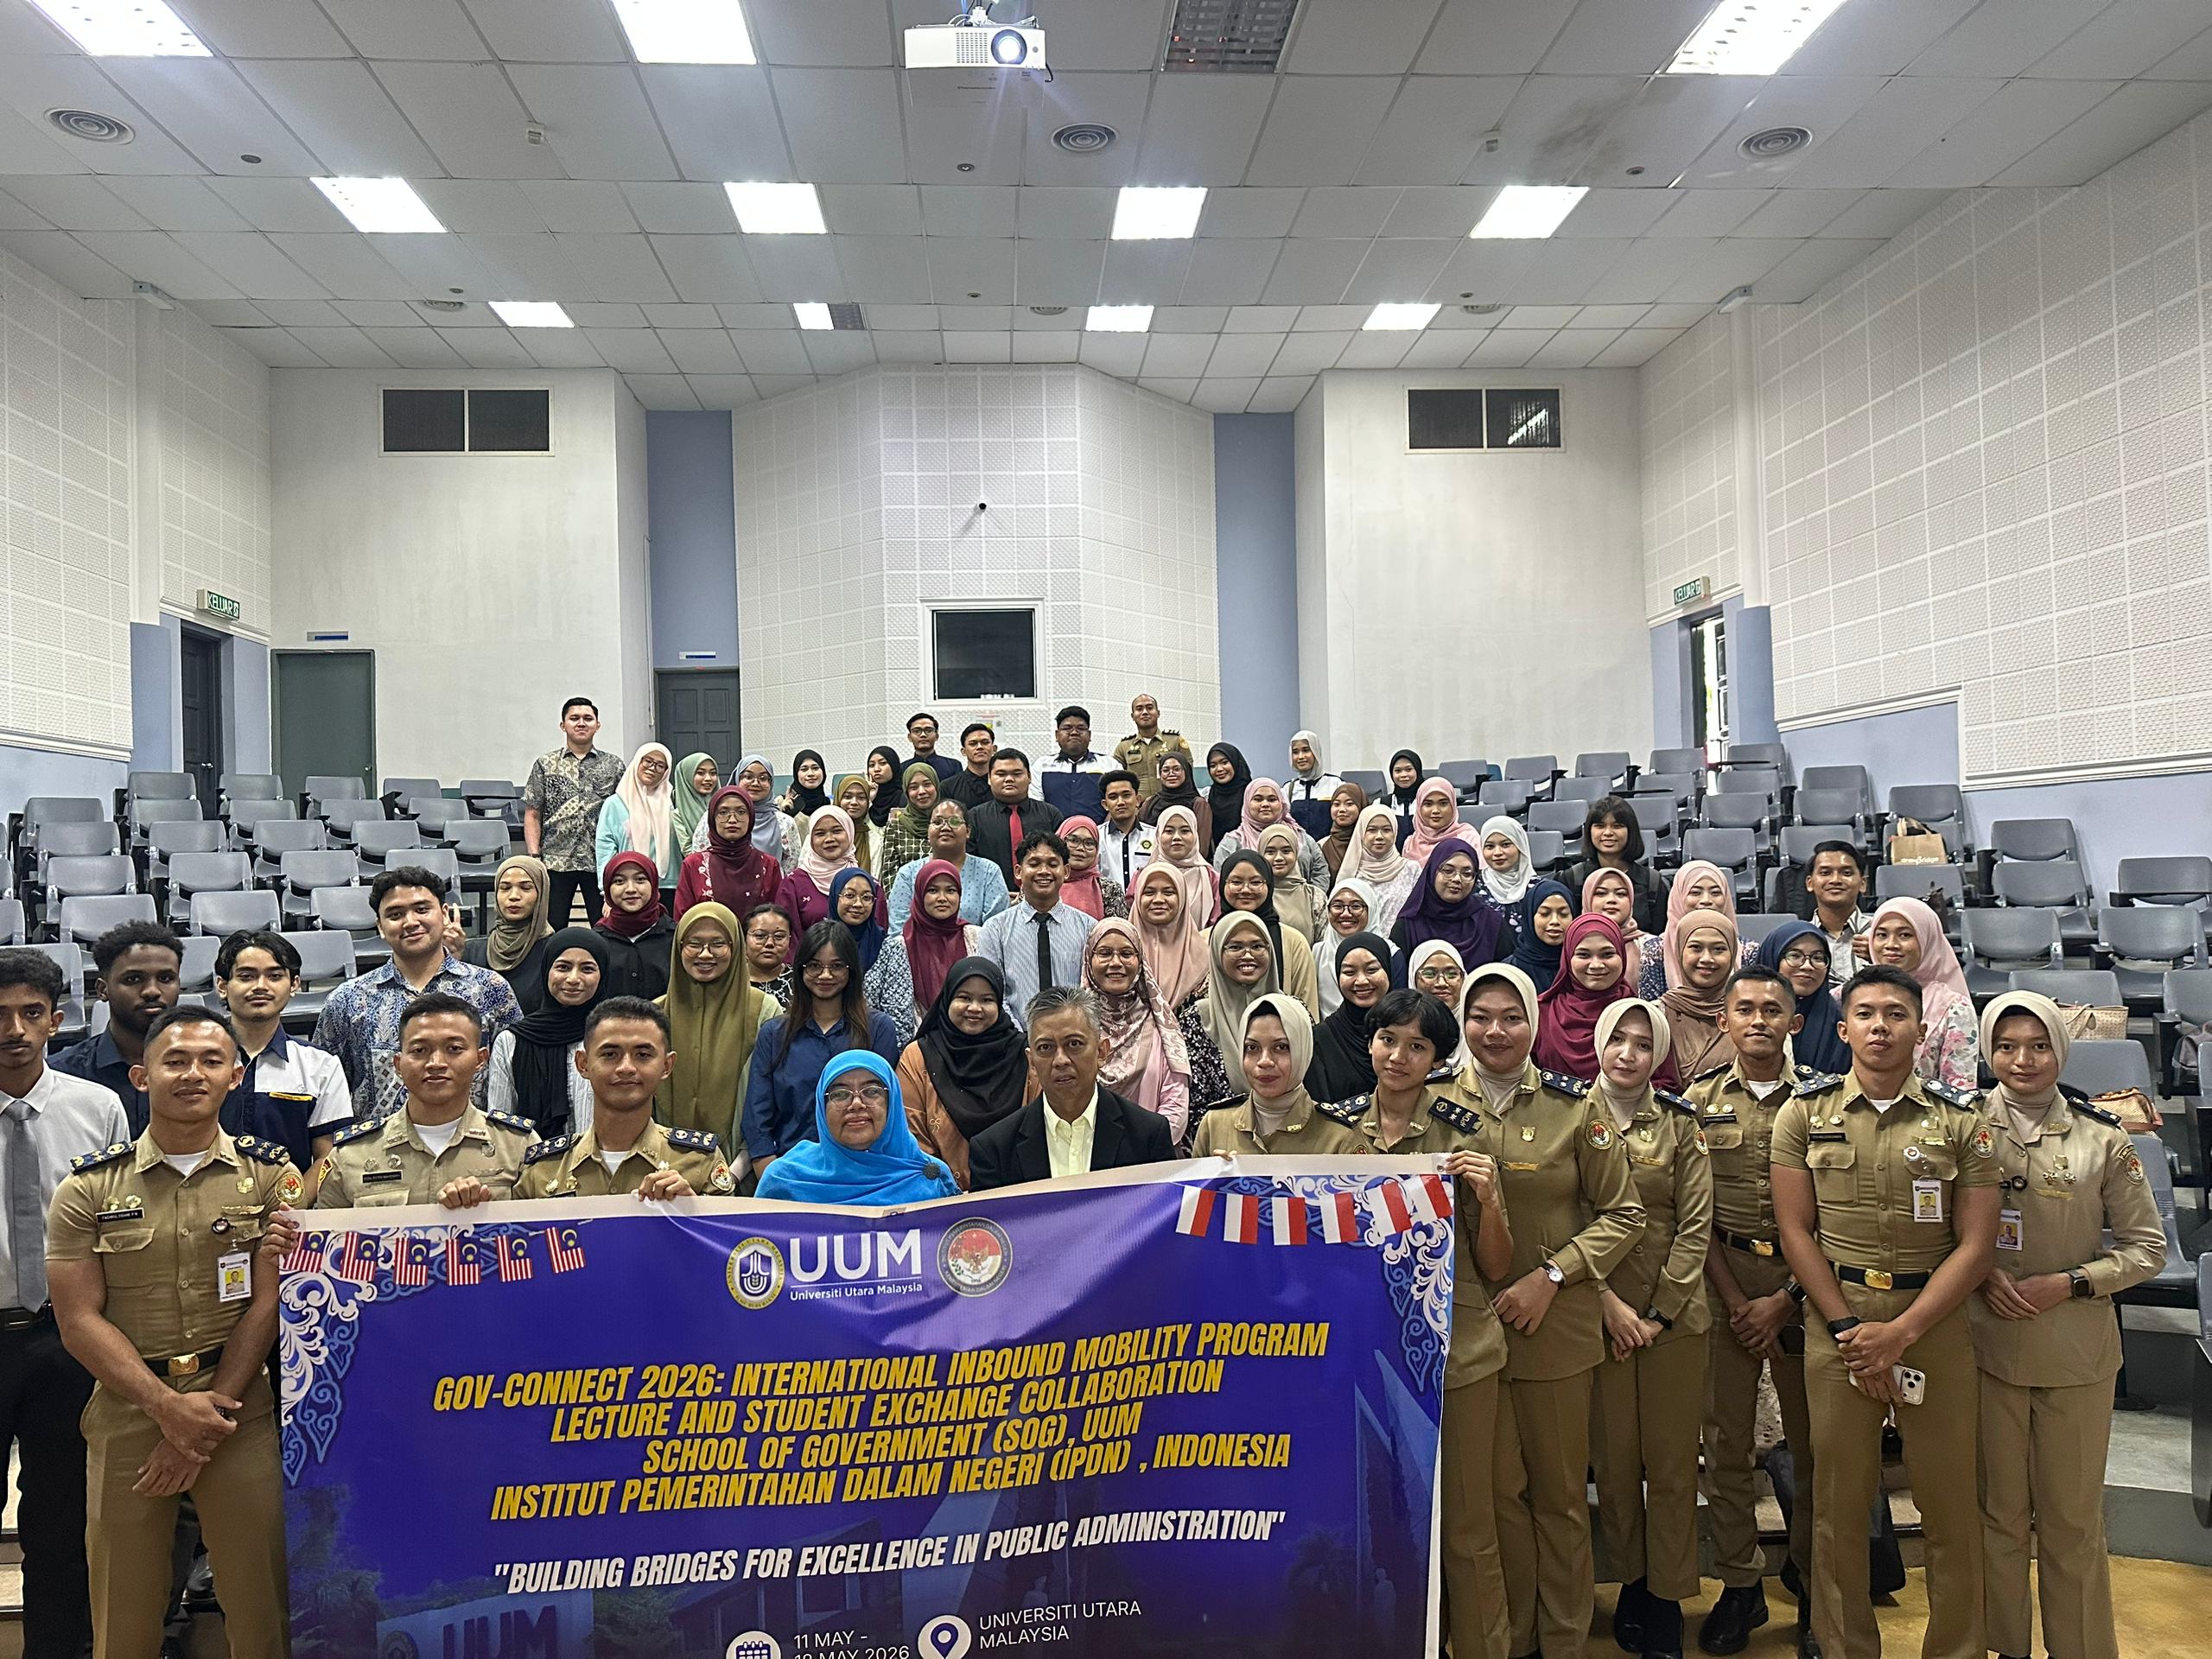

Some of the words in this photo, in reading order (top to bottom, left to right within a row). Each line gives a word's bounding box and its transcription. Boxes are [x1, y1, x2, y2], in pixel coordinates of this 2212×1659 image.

[208, 593, 233, 615] KELUAR
[1675, 582, 1695, 602] KELUAR
[790, 1228, 922, 1282] UUM
[790, 1287, 842, 1301] Universiti
[845, 1286, 874, 1297] Utara
[877, 1281, 923, 1296] Malaysia
[434, 1368, 632, 1411] GOV-CONNECT
[639, 1363, 725, 1399] 2026:
[731, 1356, 937, 1396] INTERNATIONAL
[946, 1343, 1066, 1385] INBOUND
[1071, 1325, 1191, 1372] MOBILITY
[1197, 1323, 1329, 1356] PROGRAM
[551, 1402, 672, 1442] LECTURE
[678, 1401, 736, 1434] AND
[743, 1395, 865, 1433] STUDENT
[870, 1384, 1014, 1427] EXCHANGE
[1018, 1361, 1224, 1414] COLLABORATION
[642, 1438, 747, 1473] SCHOOL
[760, 1436, 795, 1470] OF
[801, 1422, 988, 1468] GOVERNMENT
[1081, 1402, 1143, 1442] UUM
[490, 1481, 614, 1520] INSTITUT
[620, 1471, 837, 1512] PEMERINTAHAN
[843, 1462, 944, 1502] DALAM
[949, 1452, 1045, 1494] NEGERI
[1049, 1440, 1131, 1481] (IPDN)
[1153, 1434, 1290, 1467] INDONESIA
[494, 1558, 626, 1595] "BUILDING
[629, 1550, 739, 1587] BRIDGES
[742, 1548, 793, 1580] FOR
[796, 1535, 950, 1577] EXCELLENCE
[951, 1533, 982, 1565] IN
[983, 1521, 1069, 1561] PUBLIC
[1071, 1510, 1287, 1548] ADMINISTRATION"
[980, 1604, 1077, 1630] UNIVERSITI
[1083, 1600, 1141, 1618] UTARA
[794, 1634, 808, 1649] 11
[815, 1630, 855, 1648] MAY
[865, 1645, 910, 1659] 2026
[980, 1625, 1070, 1649] MALAYSIA
